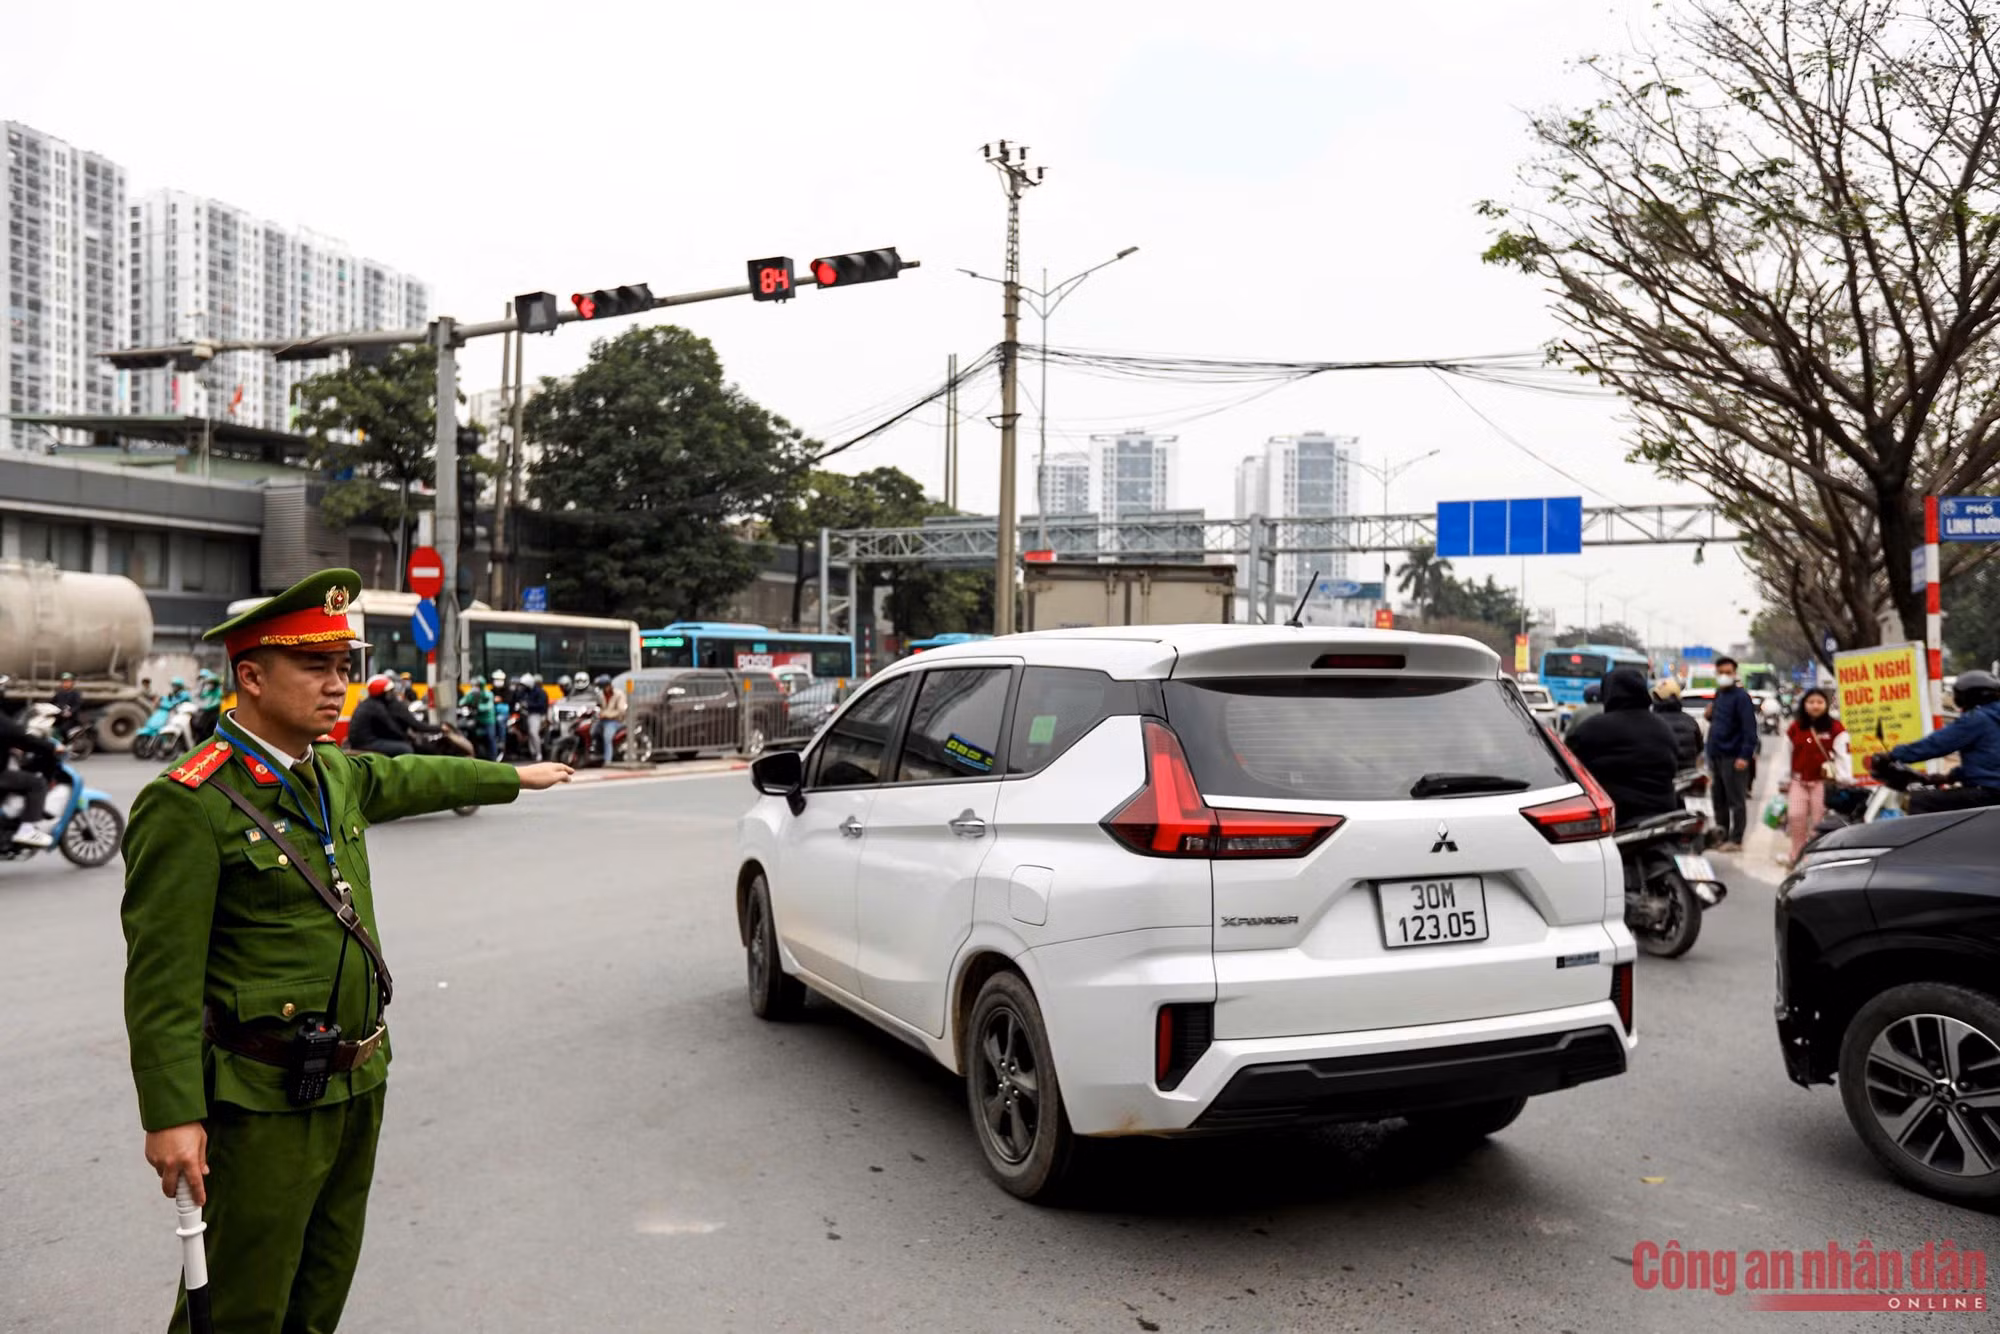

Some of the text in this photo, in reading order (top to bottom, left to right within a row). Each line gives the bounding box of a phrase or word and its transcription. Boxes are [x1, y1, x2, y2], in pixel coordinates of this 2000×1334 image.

[761, 267, 789, 293] 84
[1965, 500, 1994, 515] PHỐ
[1946, 518, 1973, 534] LINH
[1838, 660, 1870, 685] NHÀ
[1873, 652, 1912, 681] NGHỈ
[1879, 682, 1912, 703] ANH
[1410, 882, 1456, 911] 30M
[1220, 915, 1299, 928] XPANDER
[1398, 911, 1477, 943] 123.05
